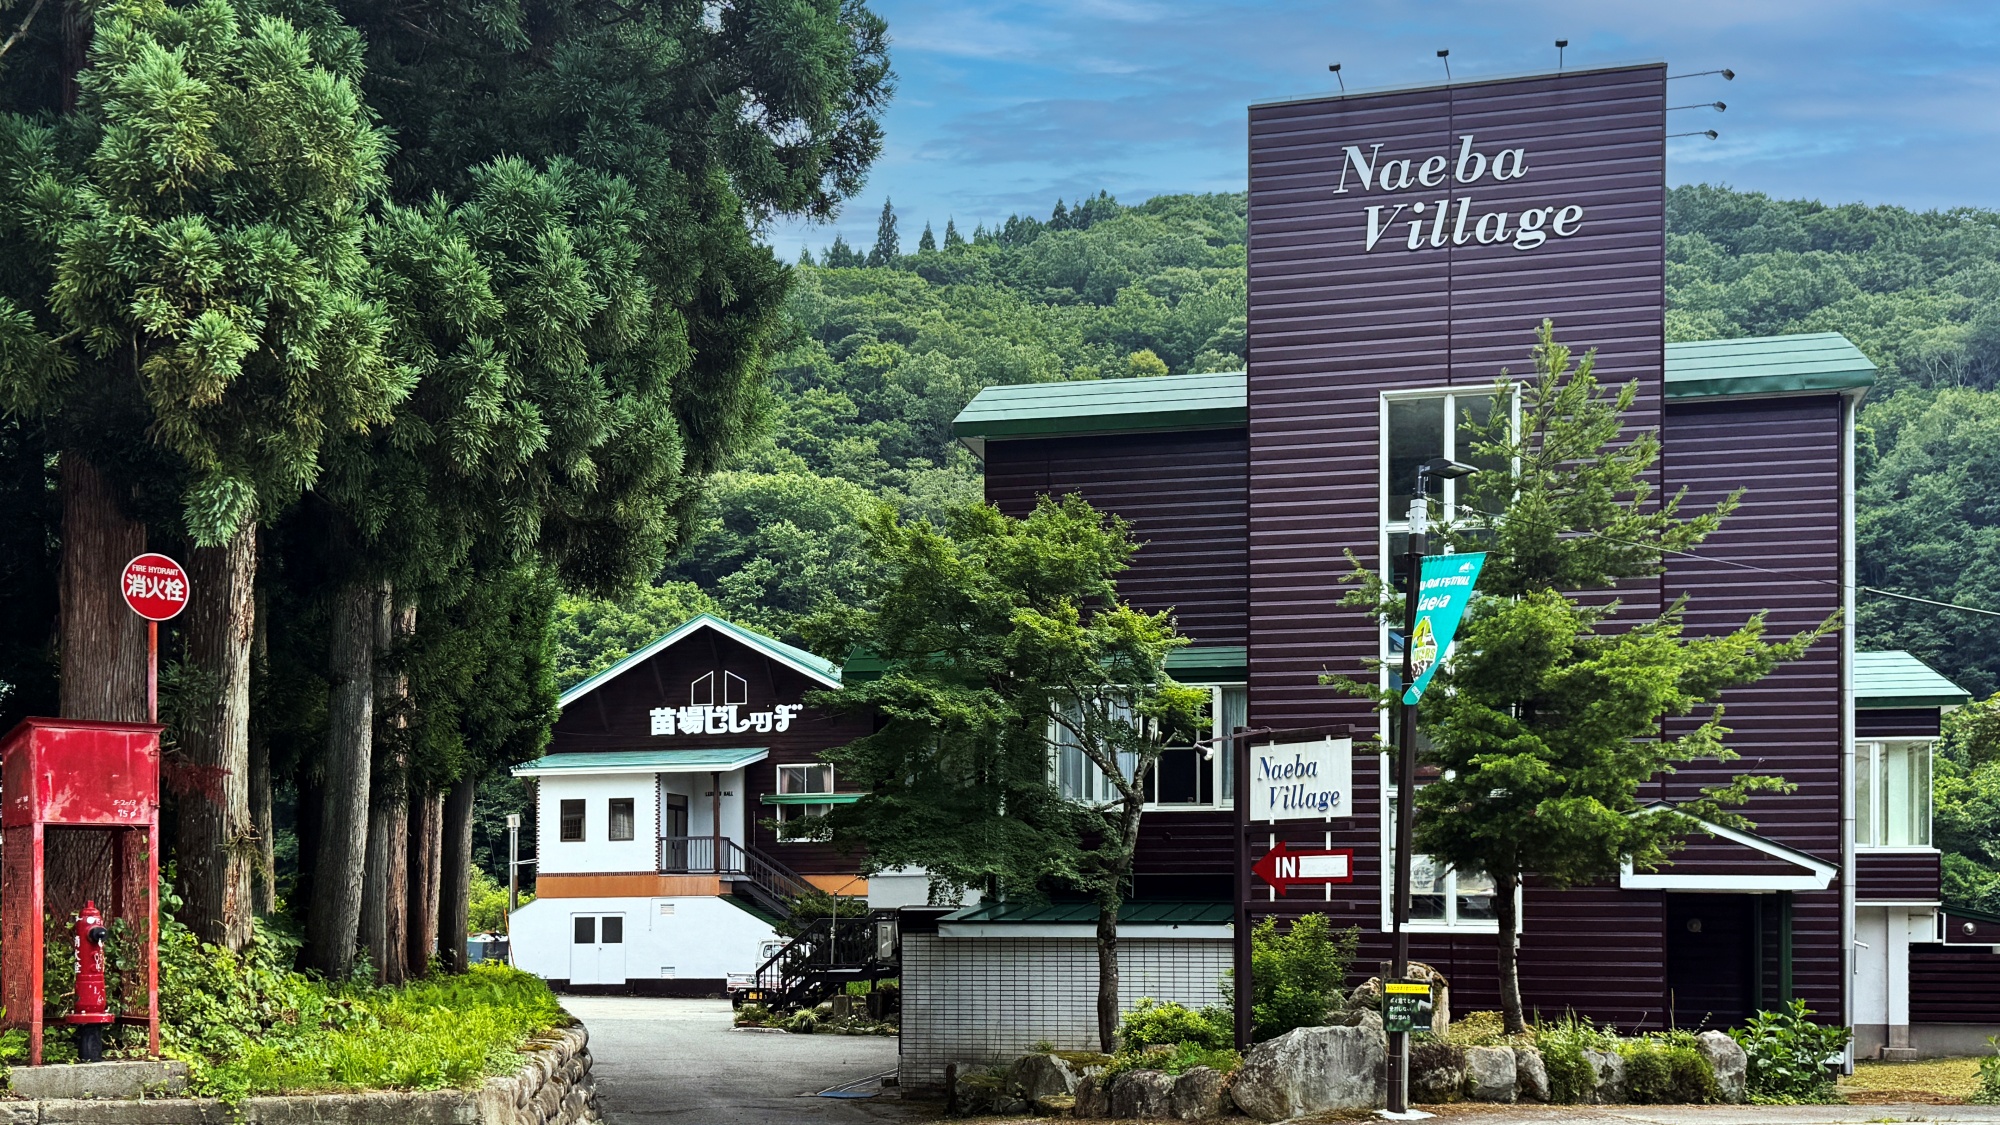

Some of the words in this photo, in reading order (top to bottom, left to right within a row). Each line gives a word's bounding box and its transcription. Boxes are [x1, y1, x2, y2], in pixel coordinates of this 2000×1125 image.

[1333, 135, 1529, 194] Naeba
[1364, 197, 1583, 251] Village
[131, 564, 147, 573] FIRE
[148, 566, 179, 576] HYDRANT
[126, 573, 185, 602] 消火栓
[650, 704, 803, 736] 苗場ビレッヂ
[1257, 754, 1318, 781] Naeba
[1269, 784, 1340, 812] Village
[1275, 856, 1296, 879] IN
